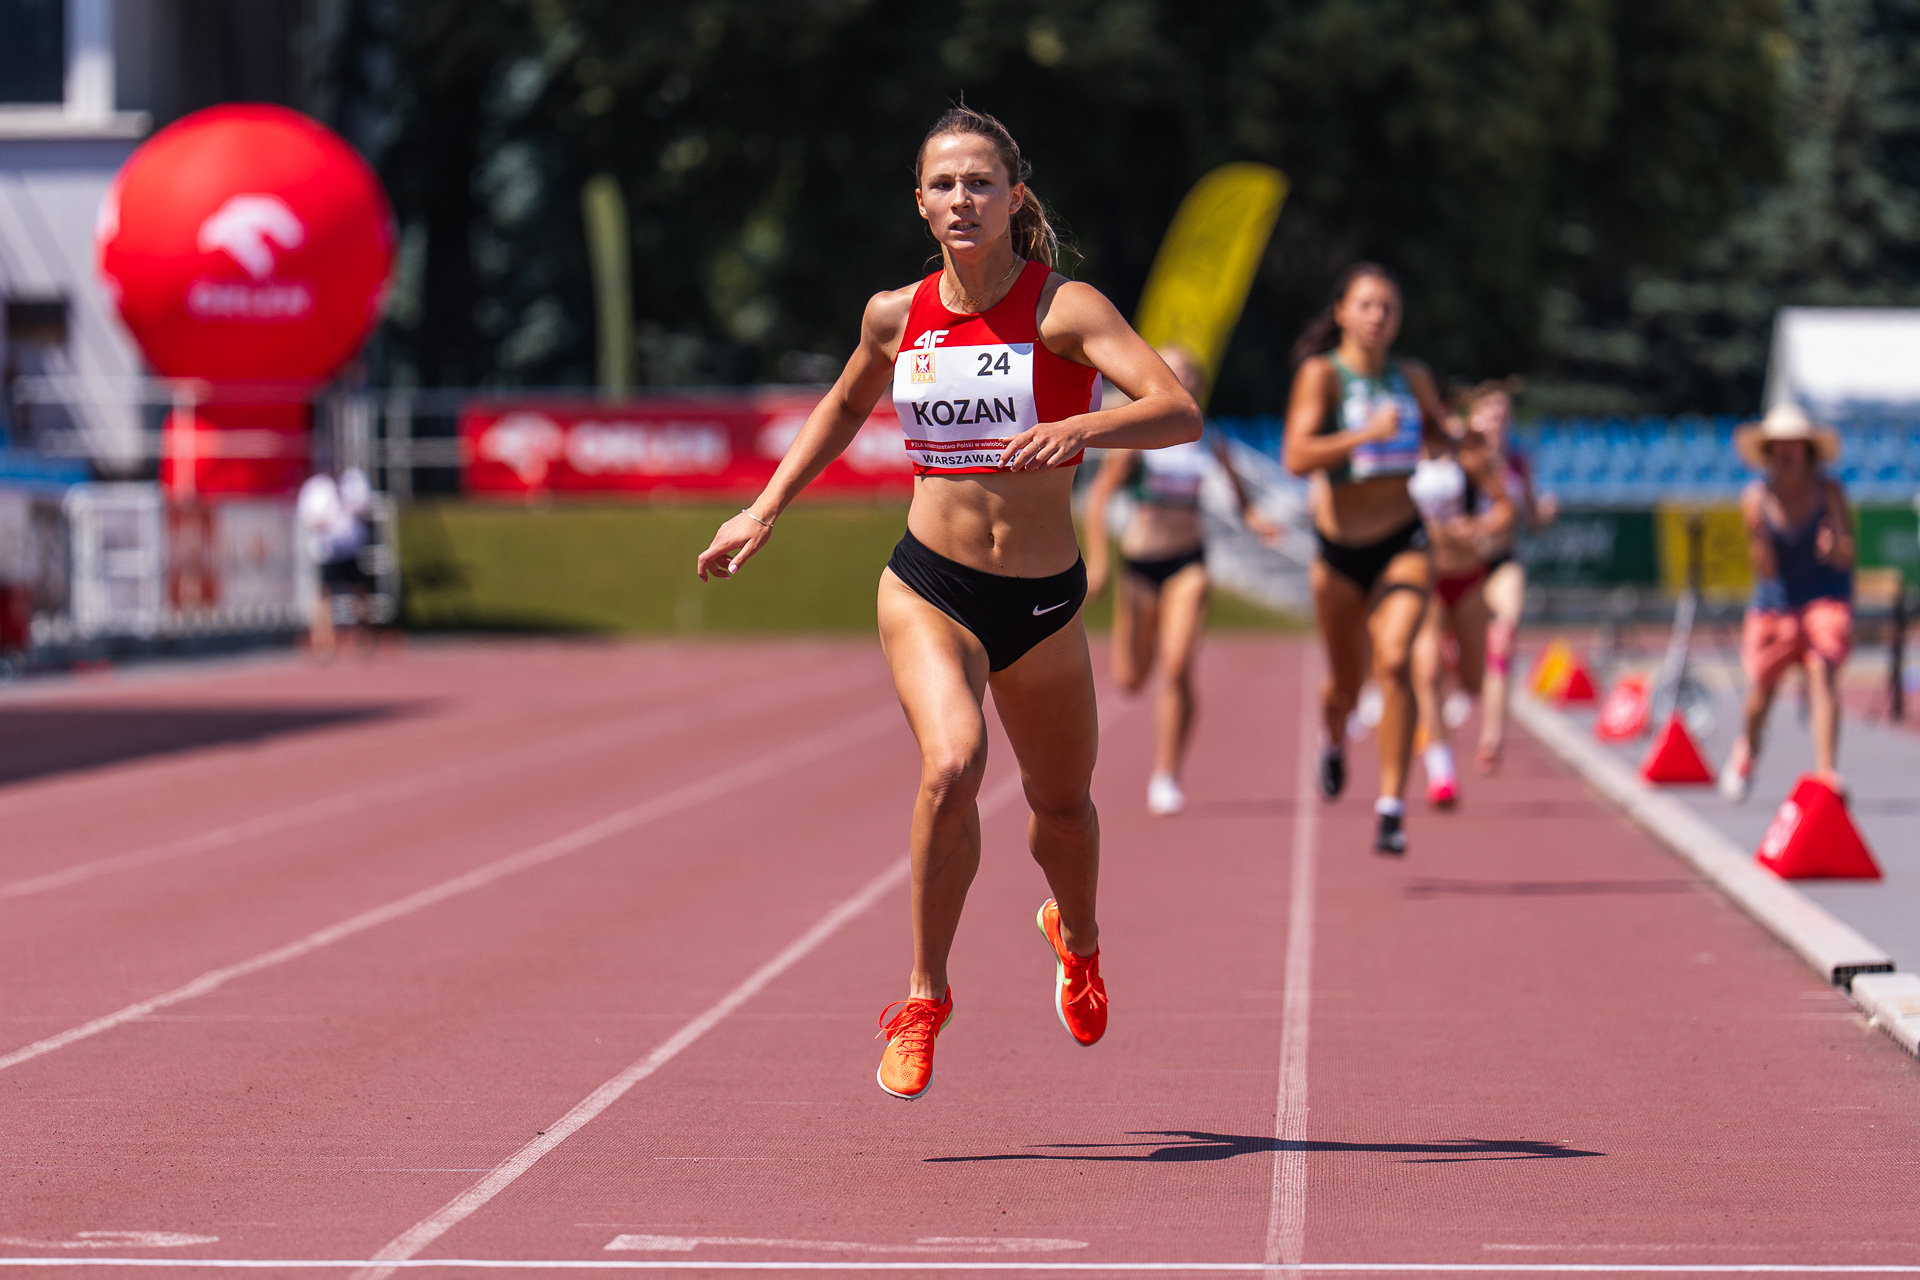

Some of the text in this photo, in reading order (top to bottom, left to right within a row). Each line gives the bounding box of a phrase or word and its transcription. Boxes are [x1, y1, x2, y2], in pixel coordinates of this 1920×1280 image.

[914, 329, 950, 349] 4F
[977, 352, 1011, 376] 24
[912, 373, 934, 382] PZLA
[911, 397, 1017, 426] KOZAN
[923, 454, 994, 465] WARSZAWA
